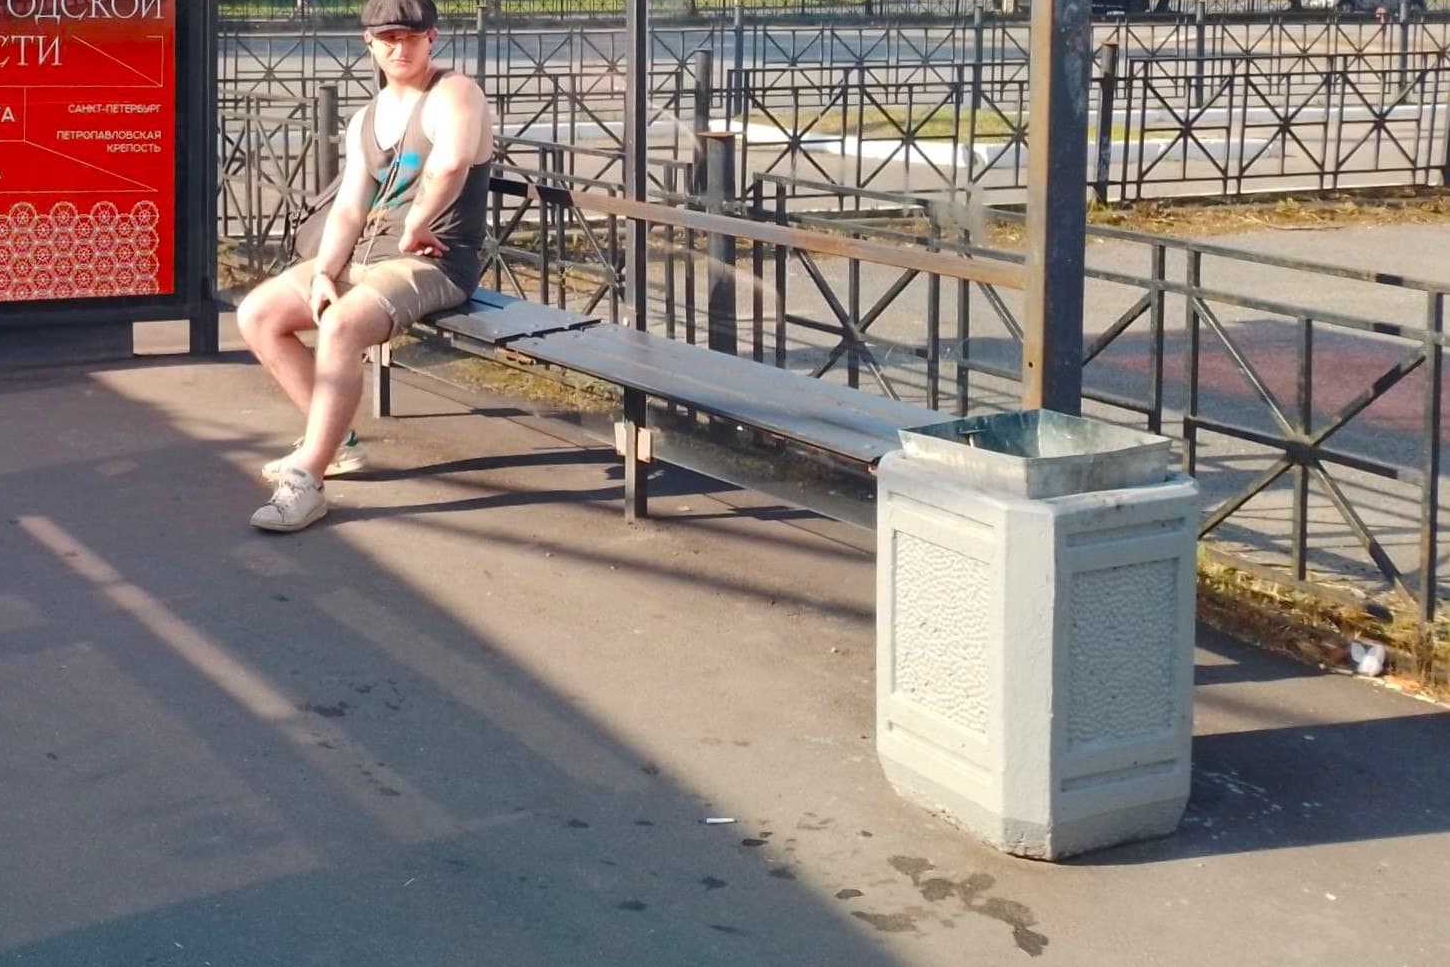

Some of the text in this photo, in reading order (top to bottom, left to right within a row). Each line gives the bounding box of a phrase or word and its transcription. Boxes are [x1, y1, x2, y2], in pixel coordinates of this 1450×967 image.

[68, 103, 162, 114] САНКТ-ПЕТЕРБУРГ
[56, 130, 162, 141] ПЕТРОПАВЛОВСКАЯ
[106, 143, 162, 154] КРЕПОСТЬ
